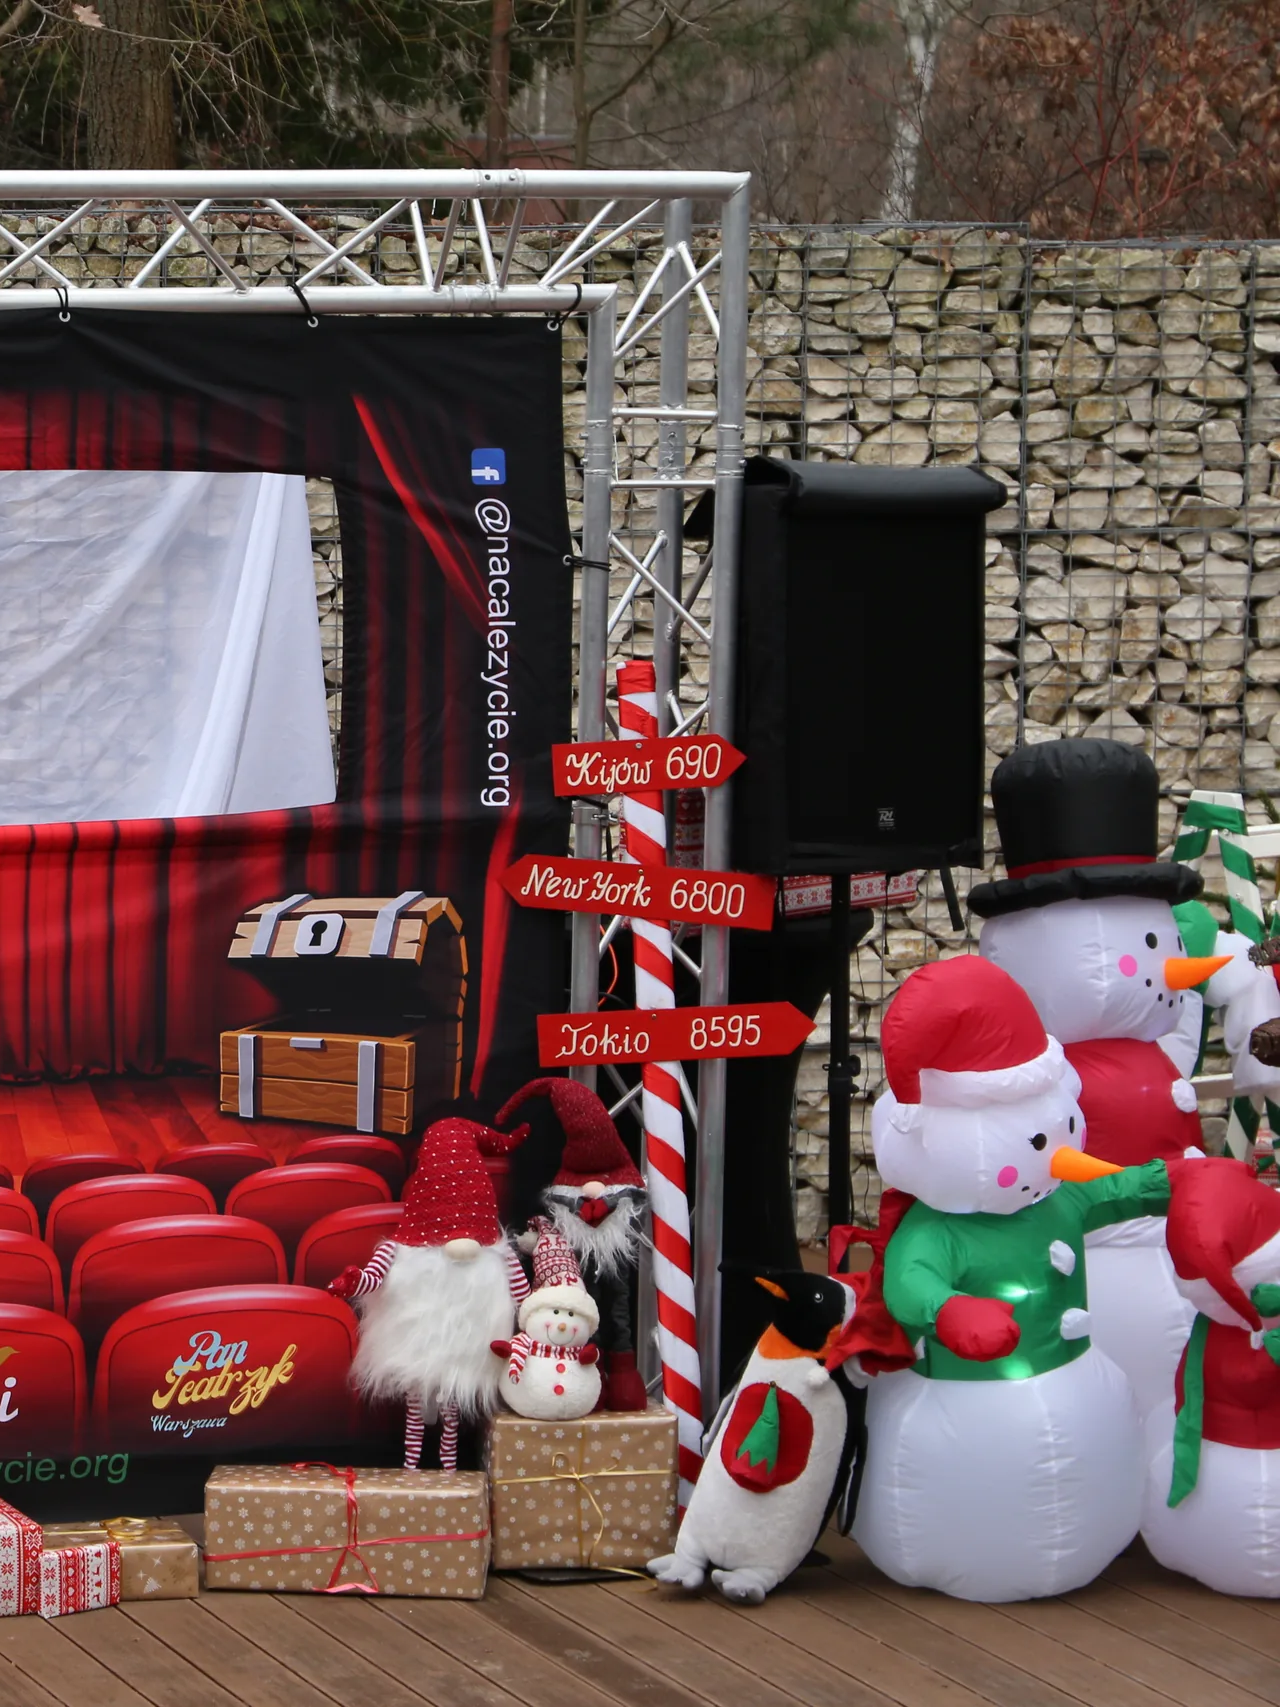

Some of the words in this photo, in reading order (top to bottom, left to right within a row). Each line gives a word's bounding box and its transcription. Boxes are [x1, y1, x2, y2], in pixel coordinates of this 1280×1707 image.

[474, 498, 516, 807] @nacalezycie.org
[566, 752, 653, 793] Kijów
[666, 743, 722, 780] 690
[521, 864, 589, 900] New
[586, 871, 651, 907] York
[670, 879, 745, 918] 6800
[555, 1022, 650, 1058] Tokio
[690, 1015, 761, 1050] 8595
[173, 1330, 248, 1376] Pan
[152, 1343, 297, 1415] Teatrzyk
[150, 1415, 228, 1438] Warszawa
